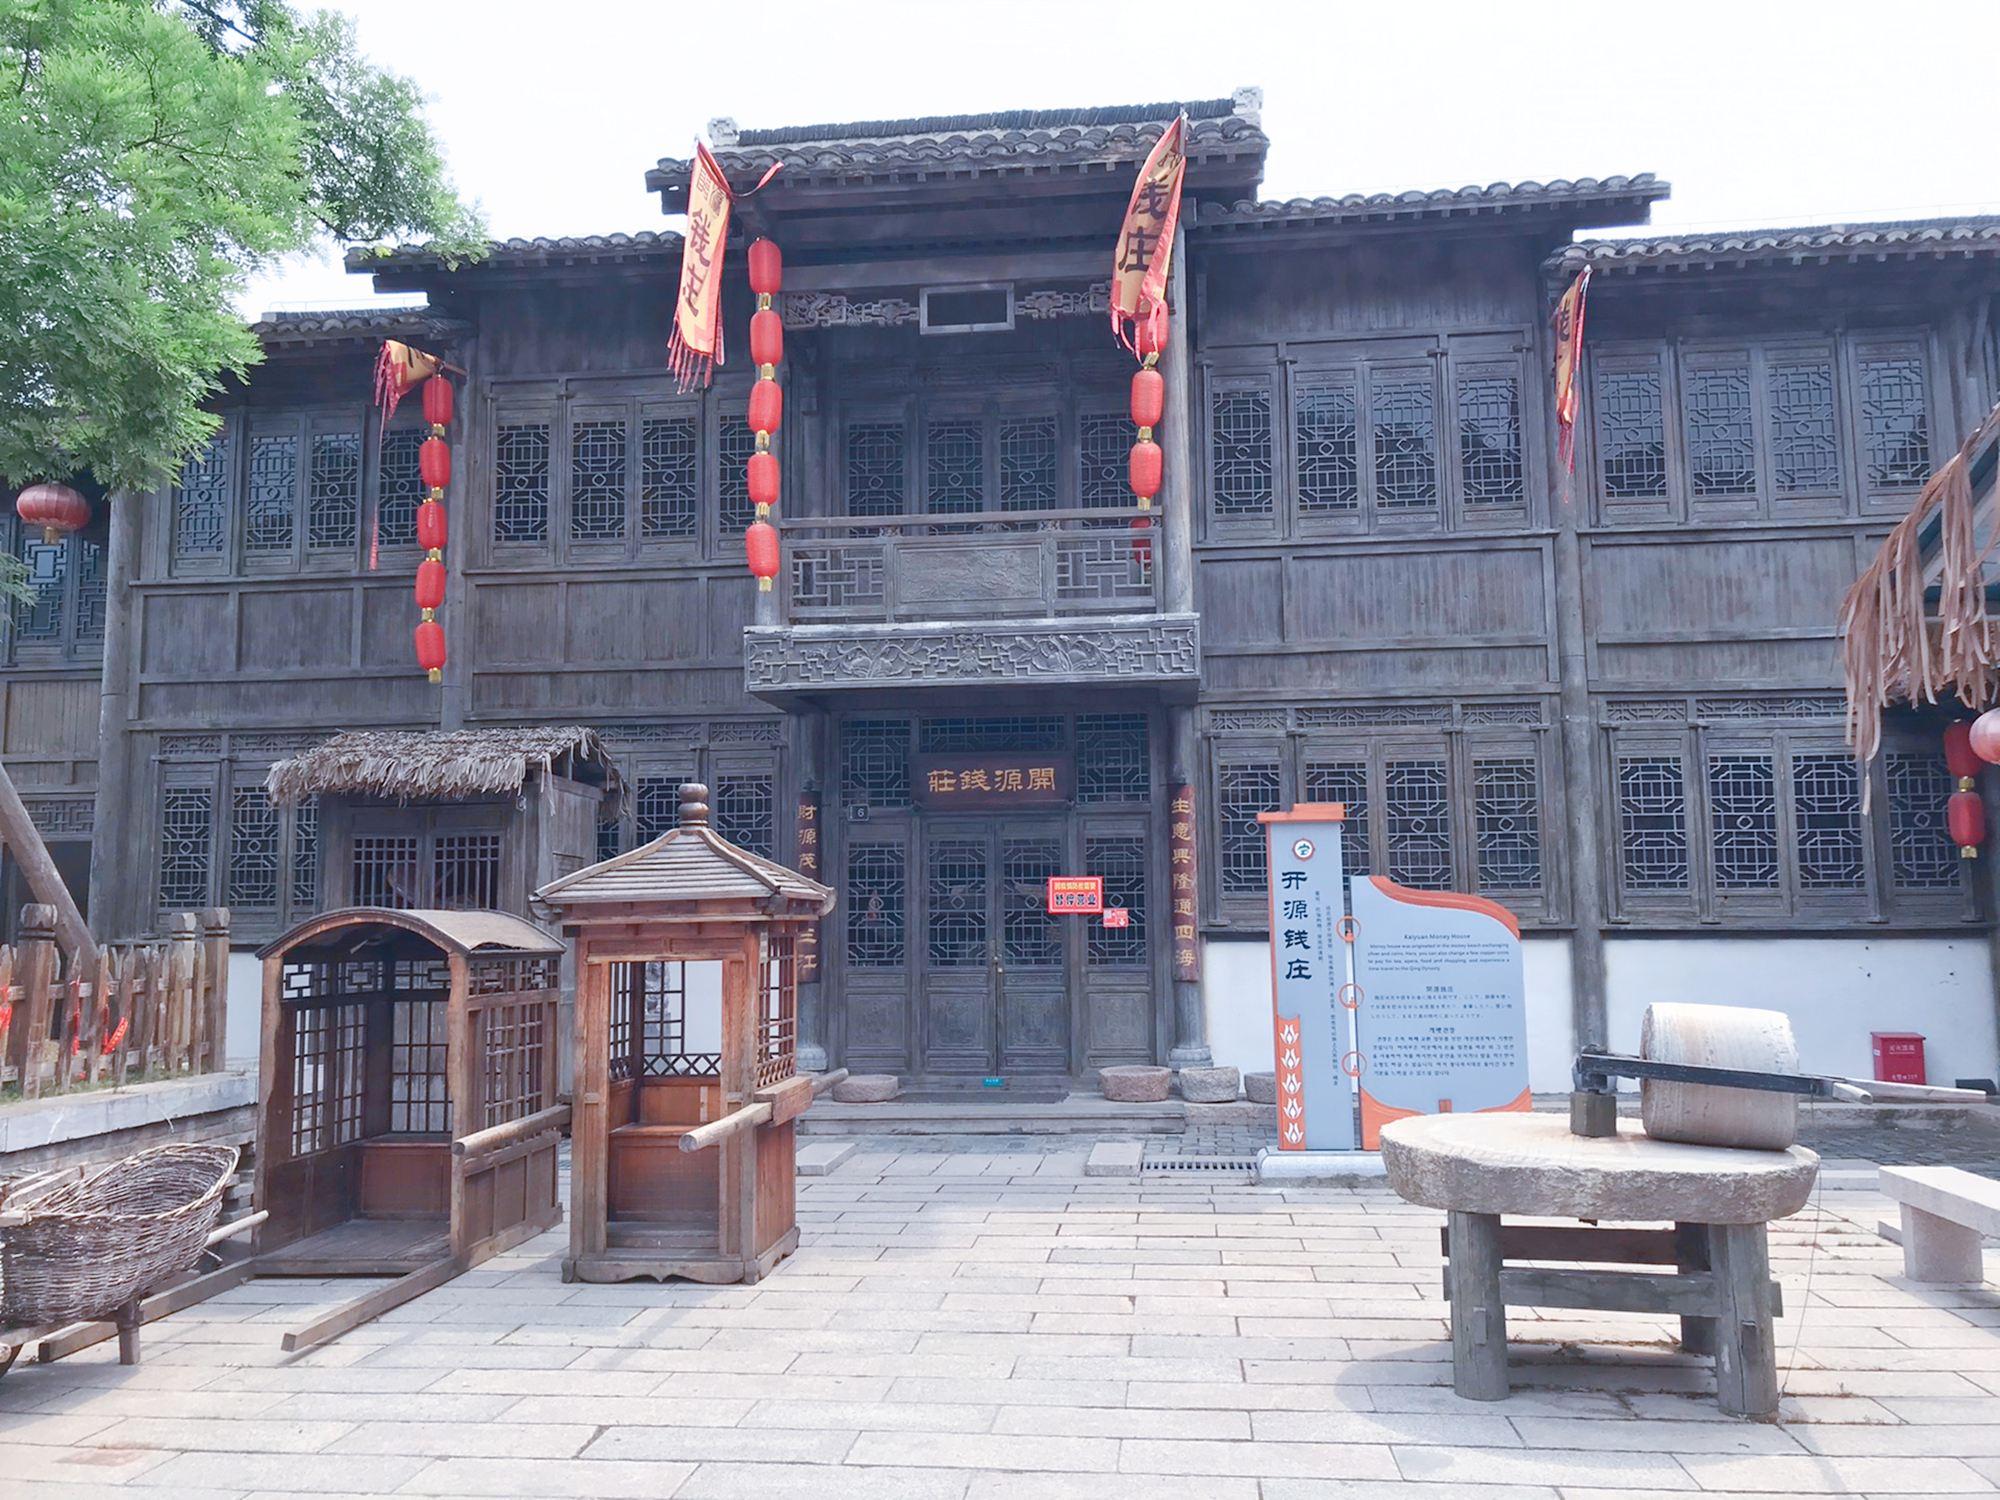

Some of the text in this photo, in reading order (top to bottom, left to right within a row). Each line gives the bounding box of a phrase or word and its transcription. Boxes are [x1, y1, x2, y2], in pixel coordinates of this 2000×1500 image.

[857, 807, 865, 818] 6
[797, 804, 817, 970] 財源茂三江
[1054, 893, 1097, 906] 暂停营业
[1171, 797, 1196, 968] 生意興隆通四海
[1281, 871, 1312, 980] 开源钱庄
